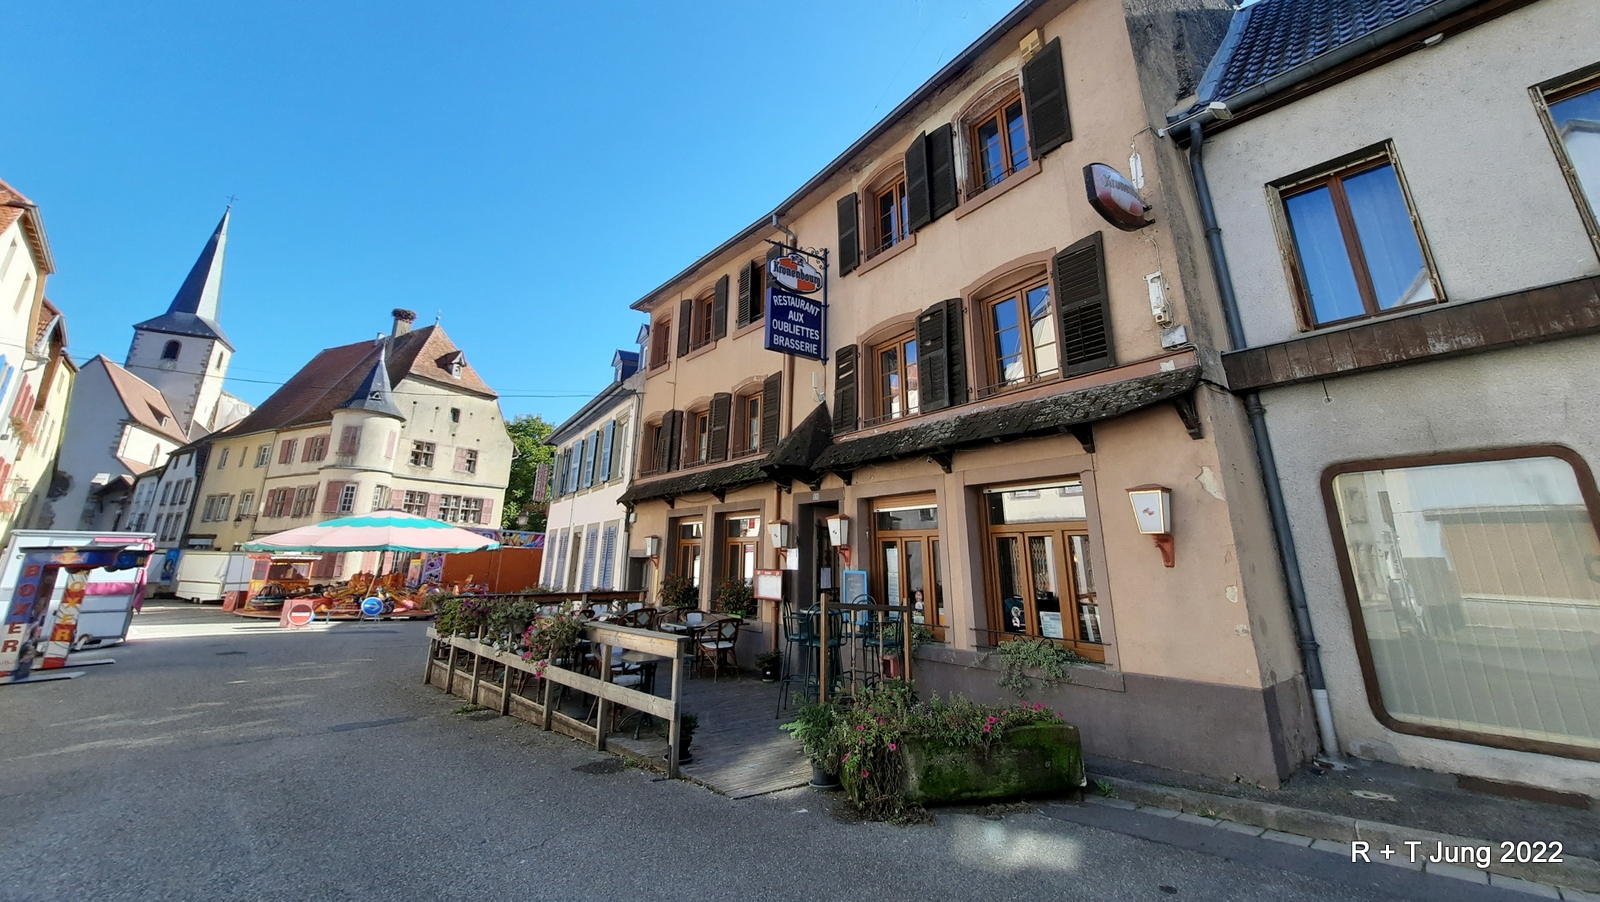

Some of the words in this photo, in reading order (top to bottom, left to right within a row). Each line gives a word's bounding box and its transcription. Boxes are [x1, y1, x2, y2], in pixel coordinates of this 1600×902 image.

[773, 260, 821, 288] Kronenbourg
[772, 295, 820, 317] RESTAURANT
[788, 310, 805, 324] AUX
[772, 318, 820, 341] OUBLIETTES
[773, 334, 818, 355] BRASSERIE
[1, 564, 41, 653] BOXER
